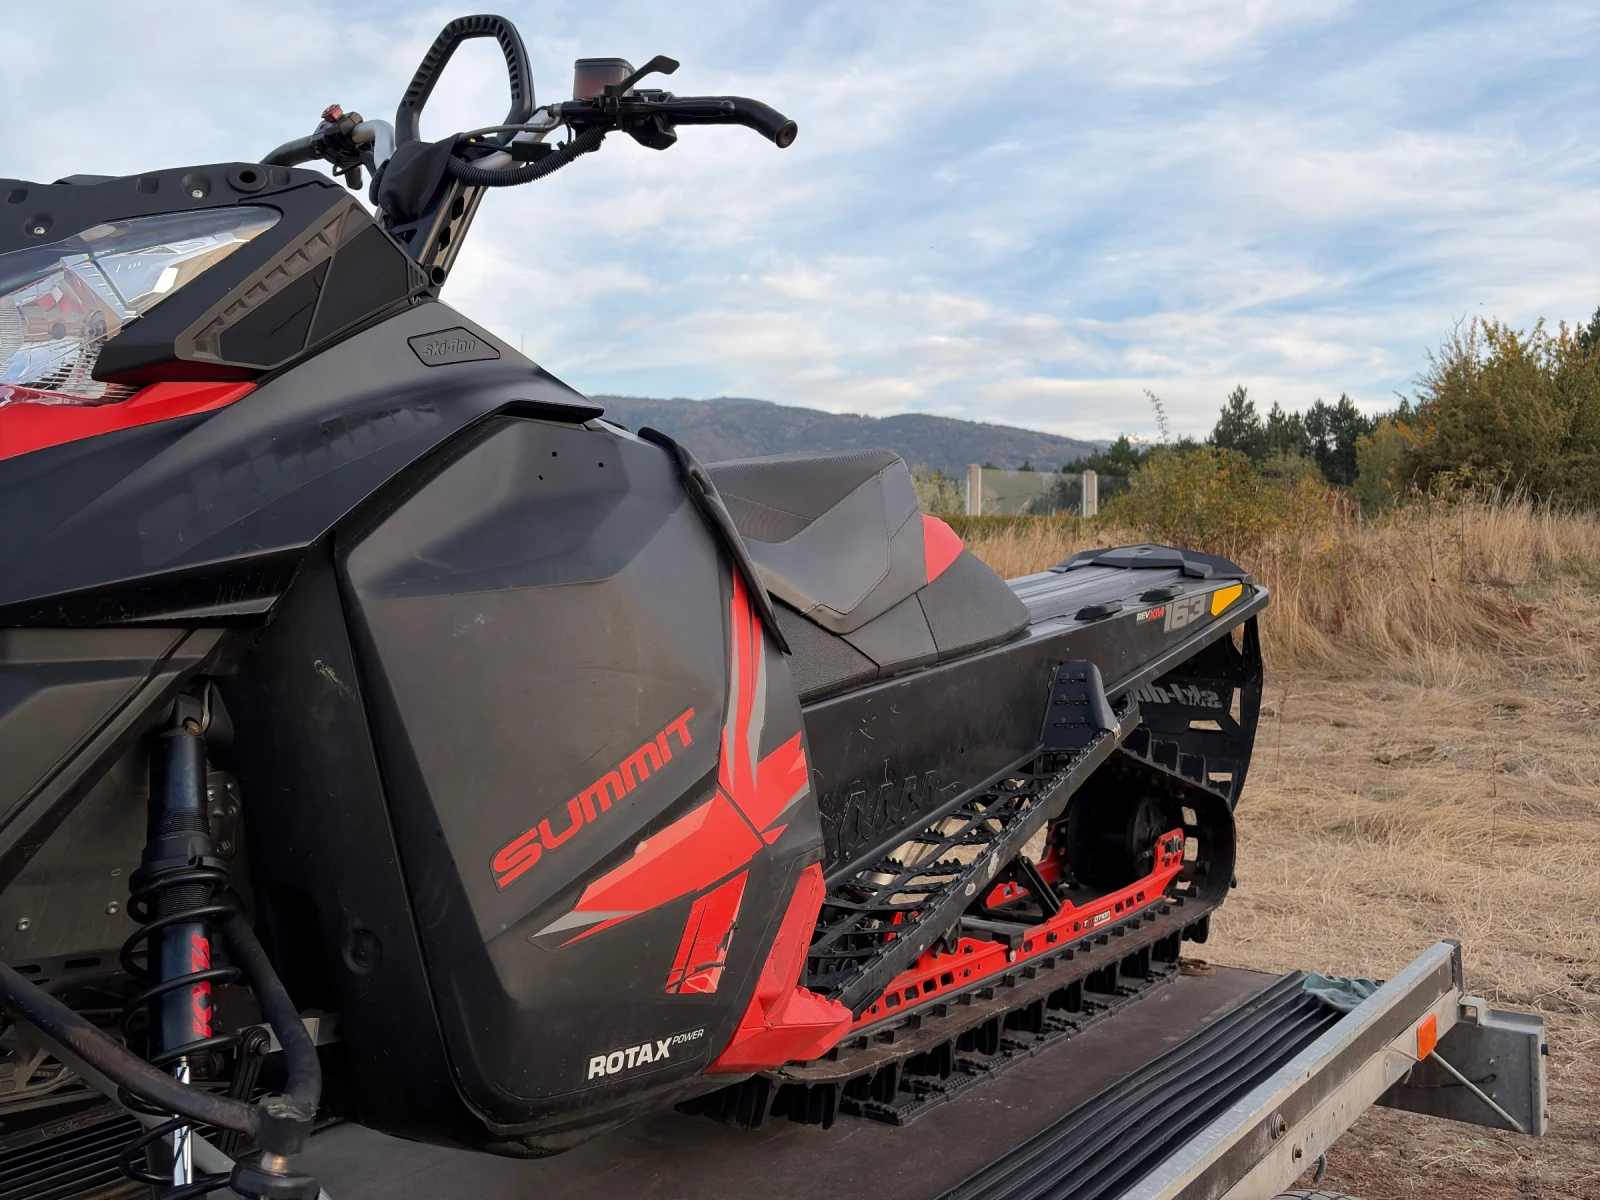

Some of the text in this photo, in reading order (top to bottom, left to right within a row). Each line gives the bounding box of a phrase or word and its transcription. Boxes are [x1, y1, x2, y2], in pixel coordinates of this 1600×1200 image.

[1164, 594, 1206, 633] 163
[493, 707, 695, 888] SUMMIT
[587, 1028, 705, 1080] ROTAX POWER
